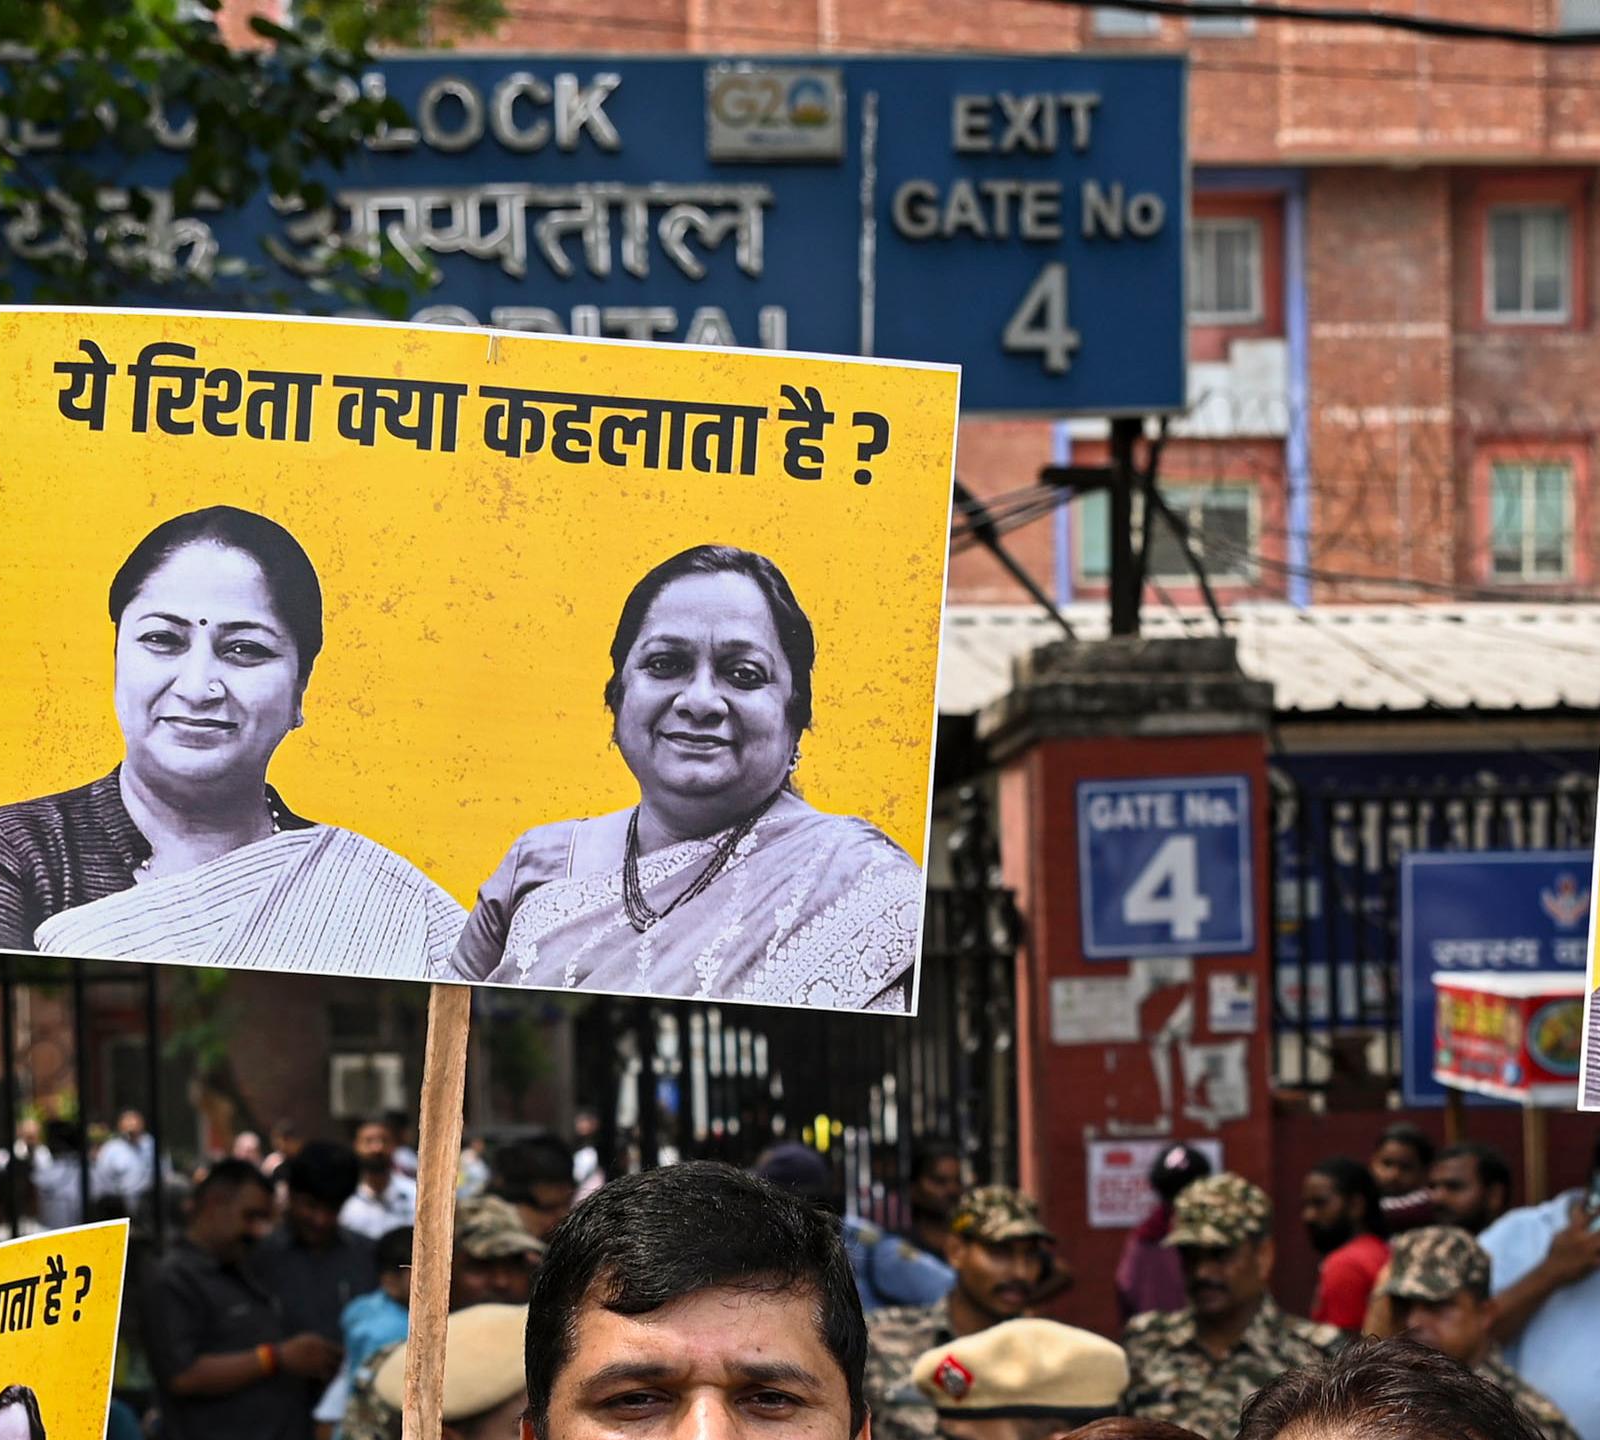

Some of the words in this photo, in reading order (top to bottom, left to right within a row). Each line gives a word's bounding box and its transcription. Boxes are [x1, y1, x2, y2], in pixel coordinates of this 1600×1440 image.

[305, 70, 623, 154] LOCK
[950, 91, 1100, 154] EXIT
[890, 177, 1064, 241] GATE
[1080, 181, 1167, 240] No
[1001, 260, 1081, 375] 4
[52, 338, 117, 433] ये
[126, 340, 323, 443] रिश्ता
[332, 373, 468, 454] क्या
[478, 384, 769, 477] कहलाता
[777, 384, 836, 481] है
[850, 411, 891, 485] ?
[1088, 793, 1177, 831] GATE
[1122, 833, 1211, 941] 4
[44, 1254, 68, 1326] है
[72, 1265, 92, 1322] ?
